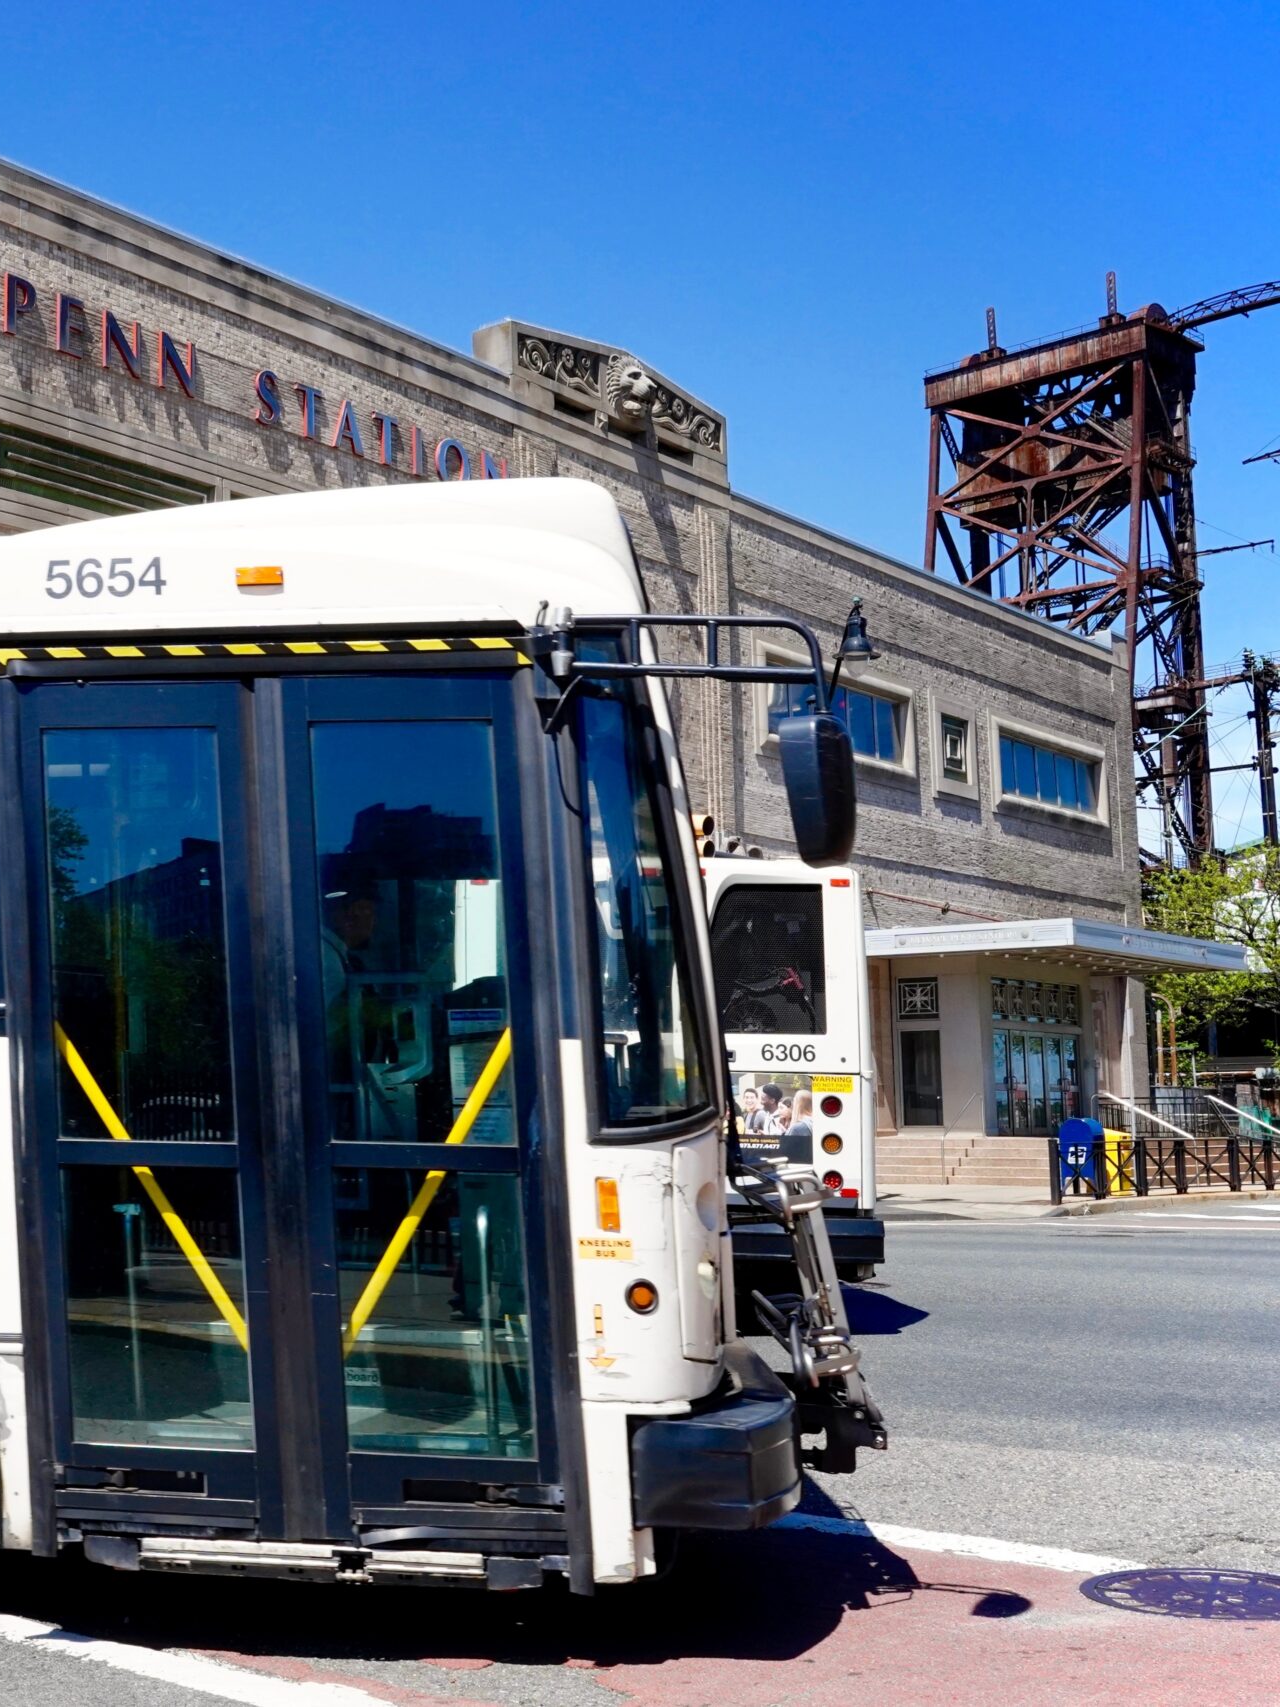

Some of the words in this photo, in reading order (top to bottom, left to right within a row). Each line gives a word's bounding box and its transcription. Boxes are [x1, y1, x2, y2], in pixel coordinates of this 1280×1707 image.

[2, 271, 197, 398] PENN
[44, 556, 167, 600] 5654
[761, 1043, 816, 1062] 6306
[579, 1239, 631, 1248] KNEELING
